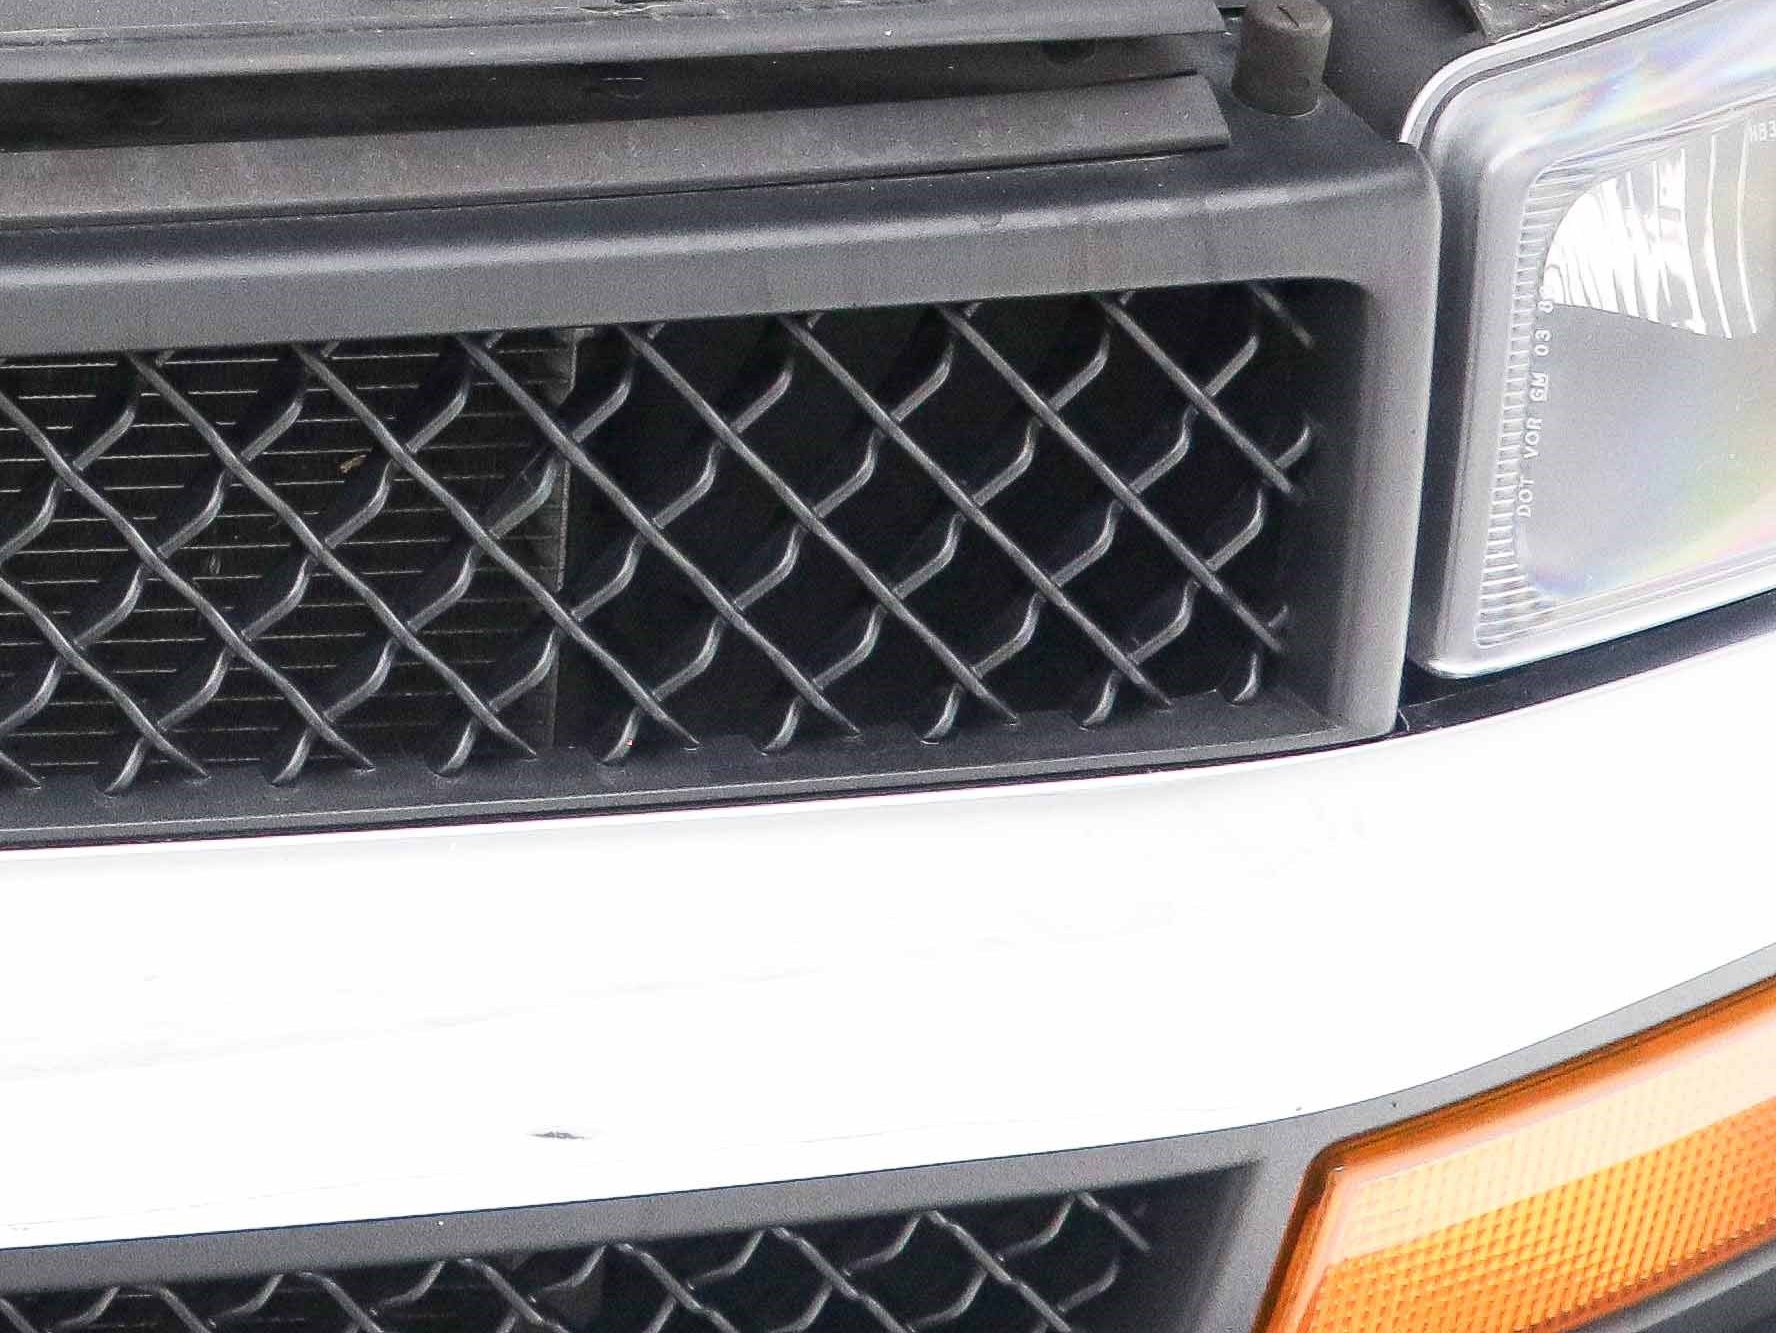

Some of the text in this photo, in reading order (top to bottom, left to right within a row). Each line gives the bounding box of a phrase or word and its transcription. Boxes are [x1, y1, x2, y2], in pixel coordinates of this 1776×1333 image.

[1534, 329, 1551, 357] 03
[1530, 372, 1549, 402] GM
[1523, 418, 1544, 459] VOR
[1515, 475, 1535, 518] DOT
